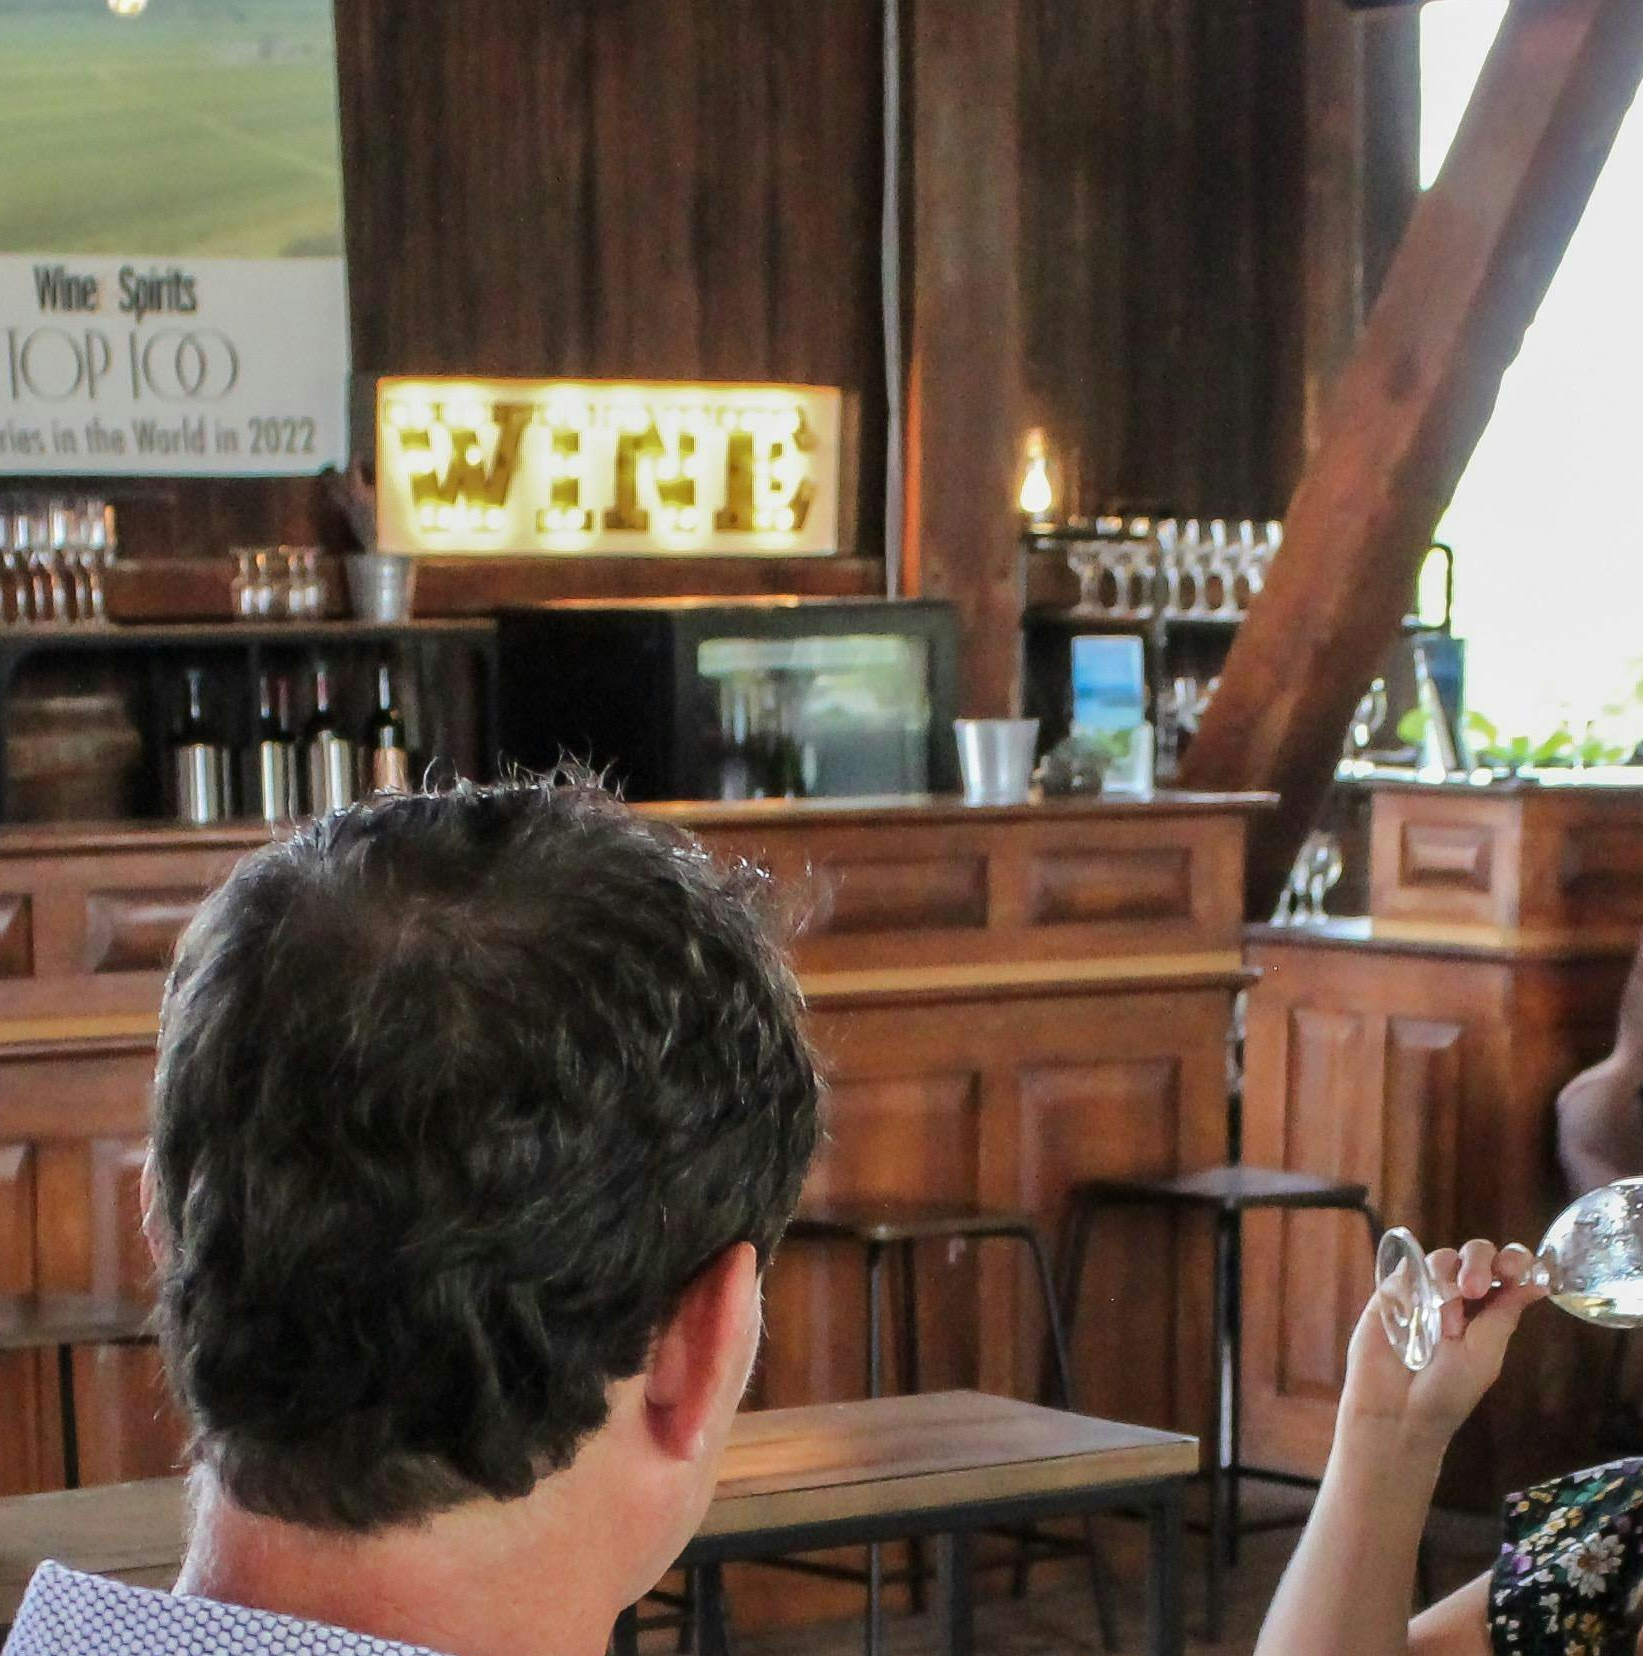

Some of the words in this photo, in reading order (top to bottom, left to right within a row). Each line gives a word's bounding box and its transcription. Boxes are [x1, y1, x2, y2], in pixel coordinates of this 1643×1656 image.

[33, 264, 98, 311] Wine
[118, 264, 197, 325] Spirits
[3, 325, 111, 401] TOP
[129, 325, 240, 402] 100
[52, 416, 78, 456] in
[83, 417, 125, 456] the
[132, 417, 206, 456] World
[214, 417, 239, 456] in
[248, 416, 317, 456] 2022
